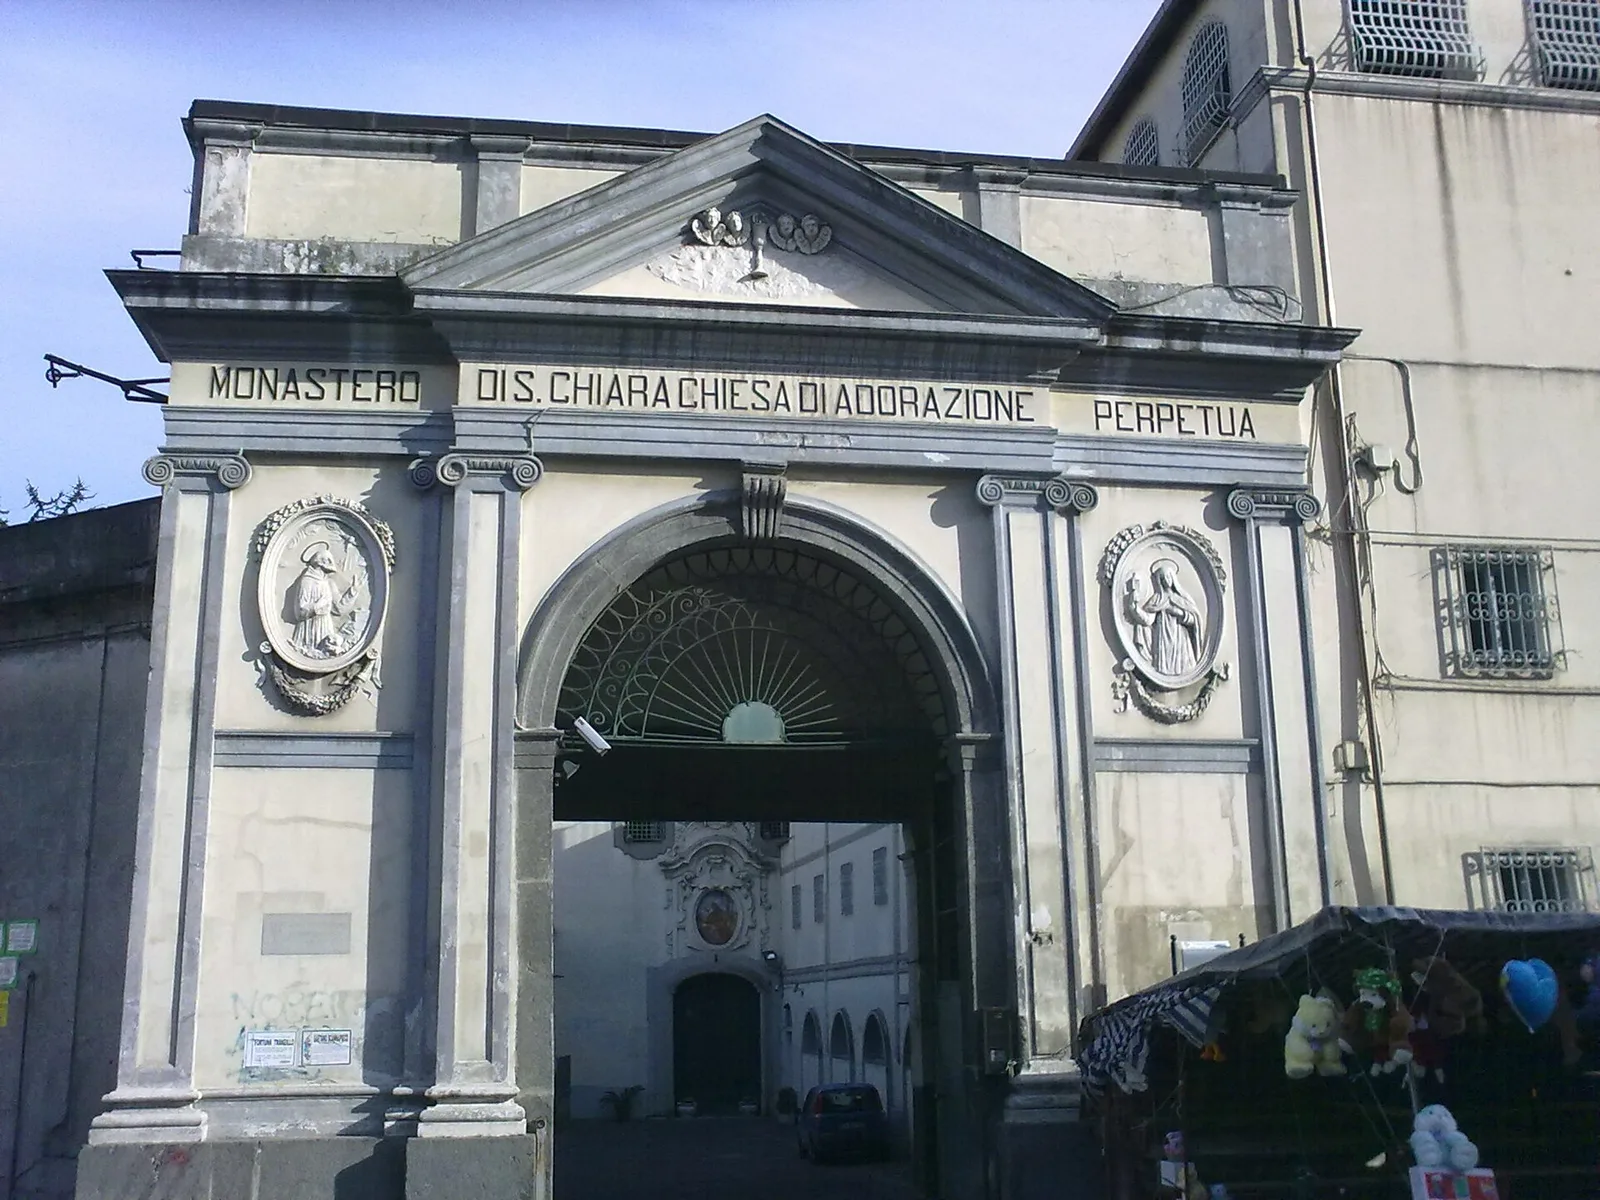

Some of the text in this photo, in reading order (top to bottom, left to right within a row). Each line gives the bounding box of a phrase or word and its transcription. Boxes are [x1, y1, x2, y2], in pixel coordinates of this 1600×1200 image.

[209, 366, 1255, 438] MONASTERO DI S. CHIARA CHIESA DI ADORAZIONE PERPETUA
